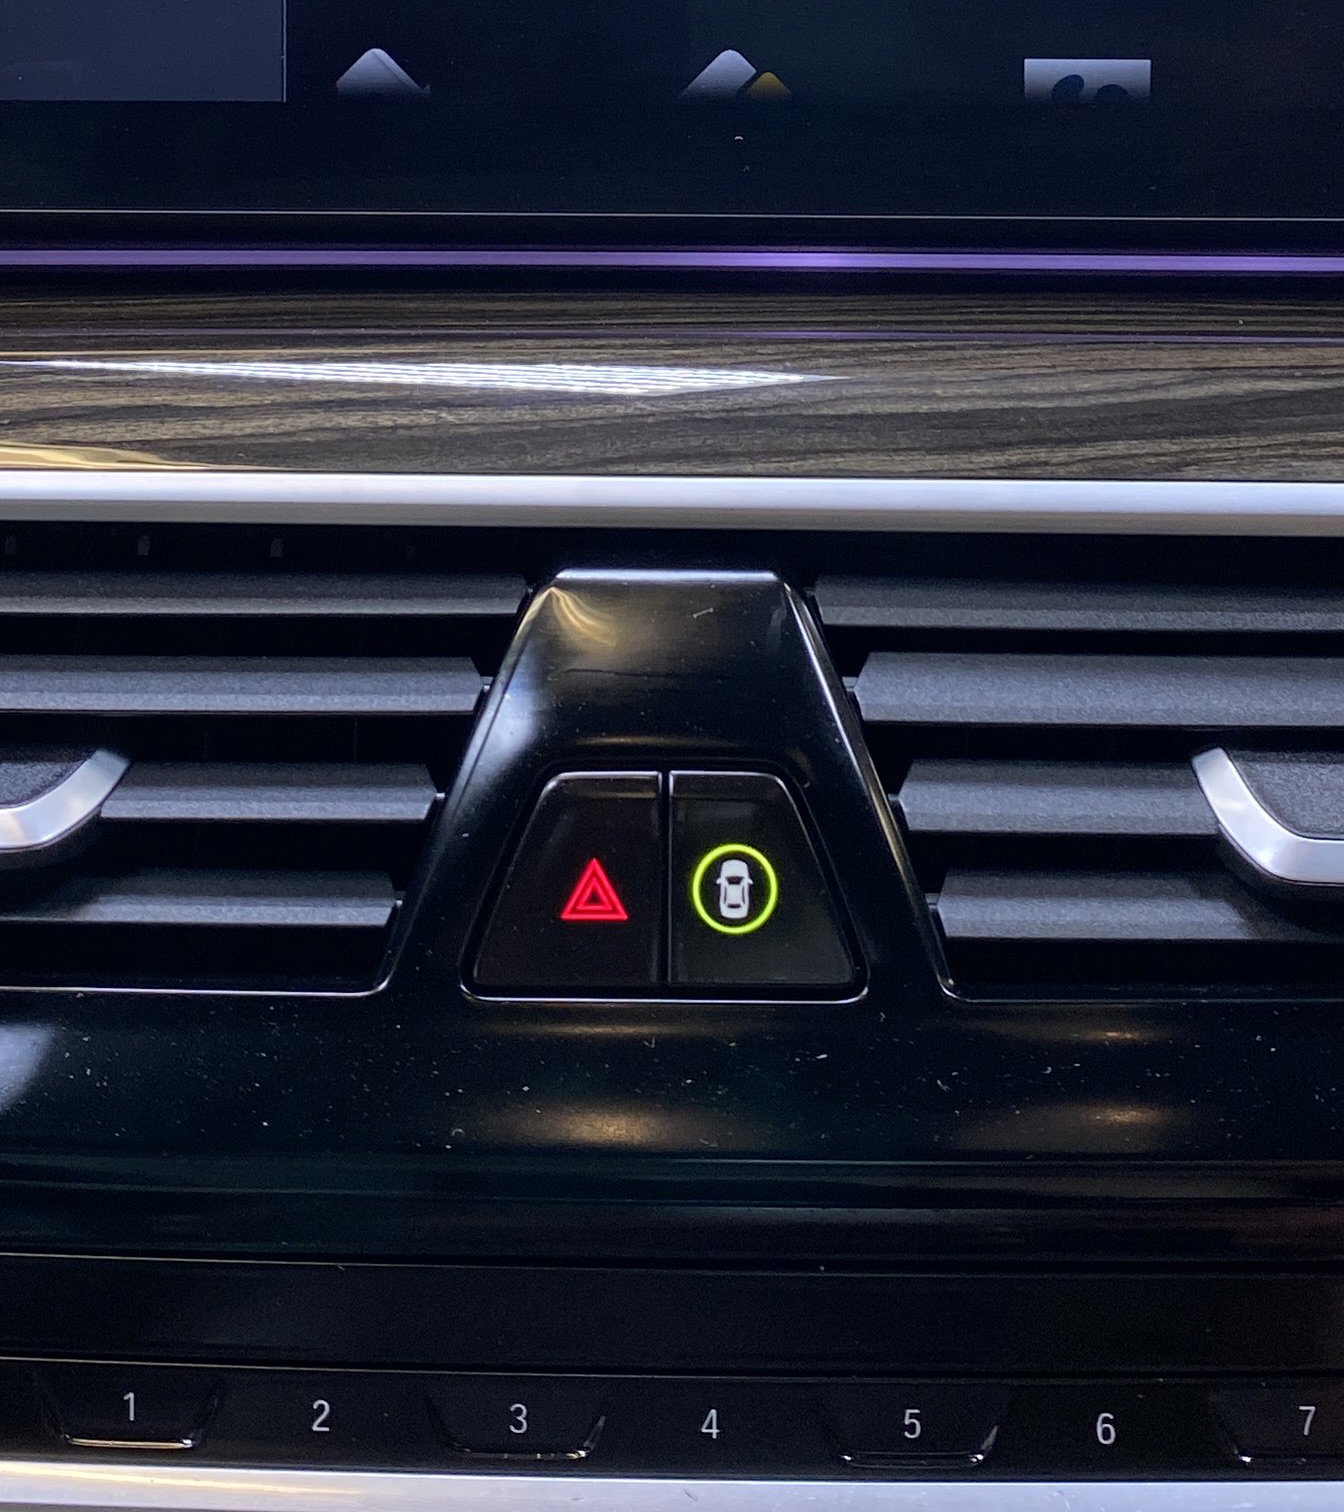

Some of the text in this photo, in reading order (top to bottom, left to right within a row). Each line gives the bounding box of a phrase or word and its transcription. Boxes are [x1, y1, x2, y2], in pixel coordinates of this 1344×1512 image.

[123, 1391, 135, 1421] 1
[311, 1399, 330, 1432] 2
[509, 1403, 528, 1434] 3
[1298, 1405, 1316, 1436] 7
[700, 1408, 720, 1439] 4
[903, 1408, 921, 1439] 5
[1096, 1412, 1116, 1445] 6
